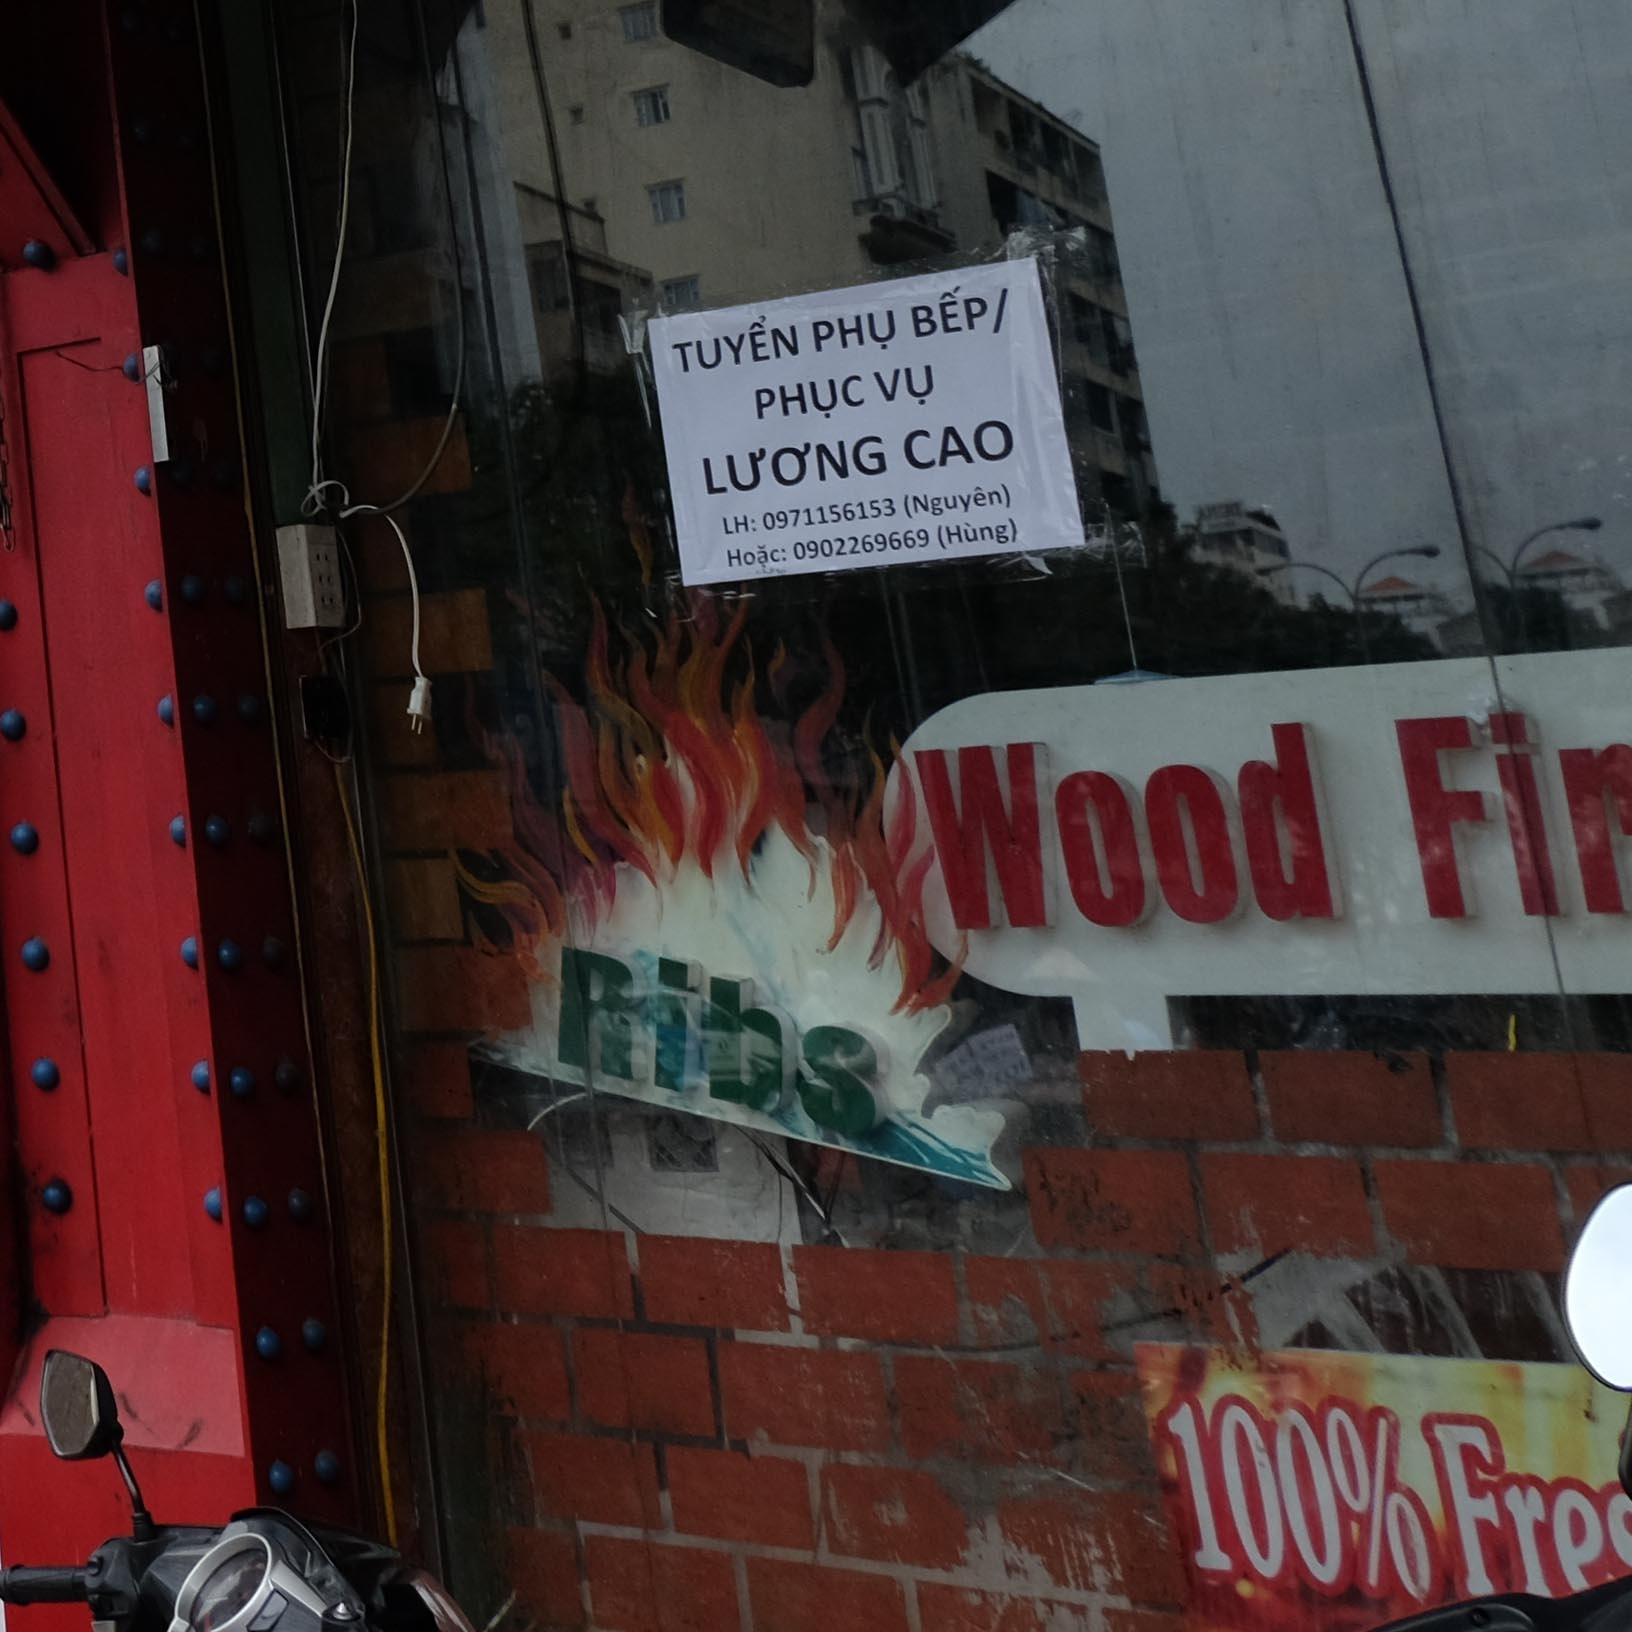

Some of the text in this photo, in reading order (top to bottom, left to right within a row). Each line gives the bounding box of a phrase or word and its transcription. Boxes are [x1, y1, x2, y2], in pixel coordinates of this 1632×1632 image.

[673, 286, 1009, 374] TUYỂN PHỤ BẾP/
[754, 364, 936, 420] PHỤC VỤ
[702, 419, 1015, 496] LƯƠNG CAO
[722, 484, 1012, 536] LH: 0971156153 (Nguyên)
[727, 518, 1018, 568] Hoặc: 0902269669 (Hùng)
[914, 721, 1341, 934] Wood
[558, 946, 878, 1135] Ribs
[1169, 1400, 1431, 1593] 100%
